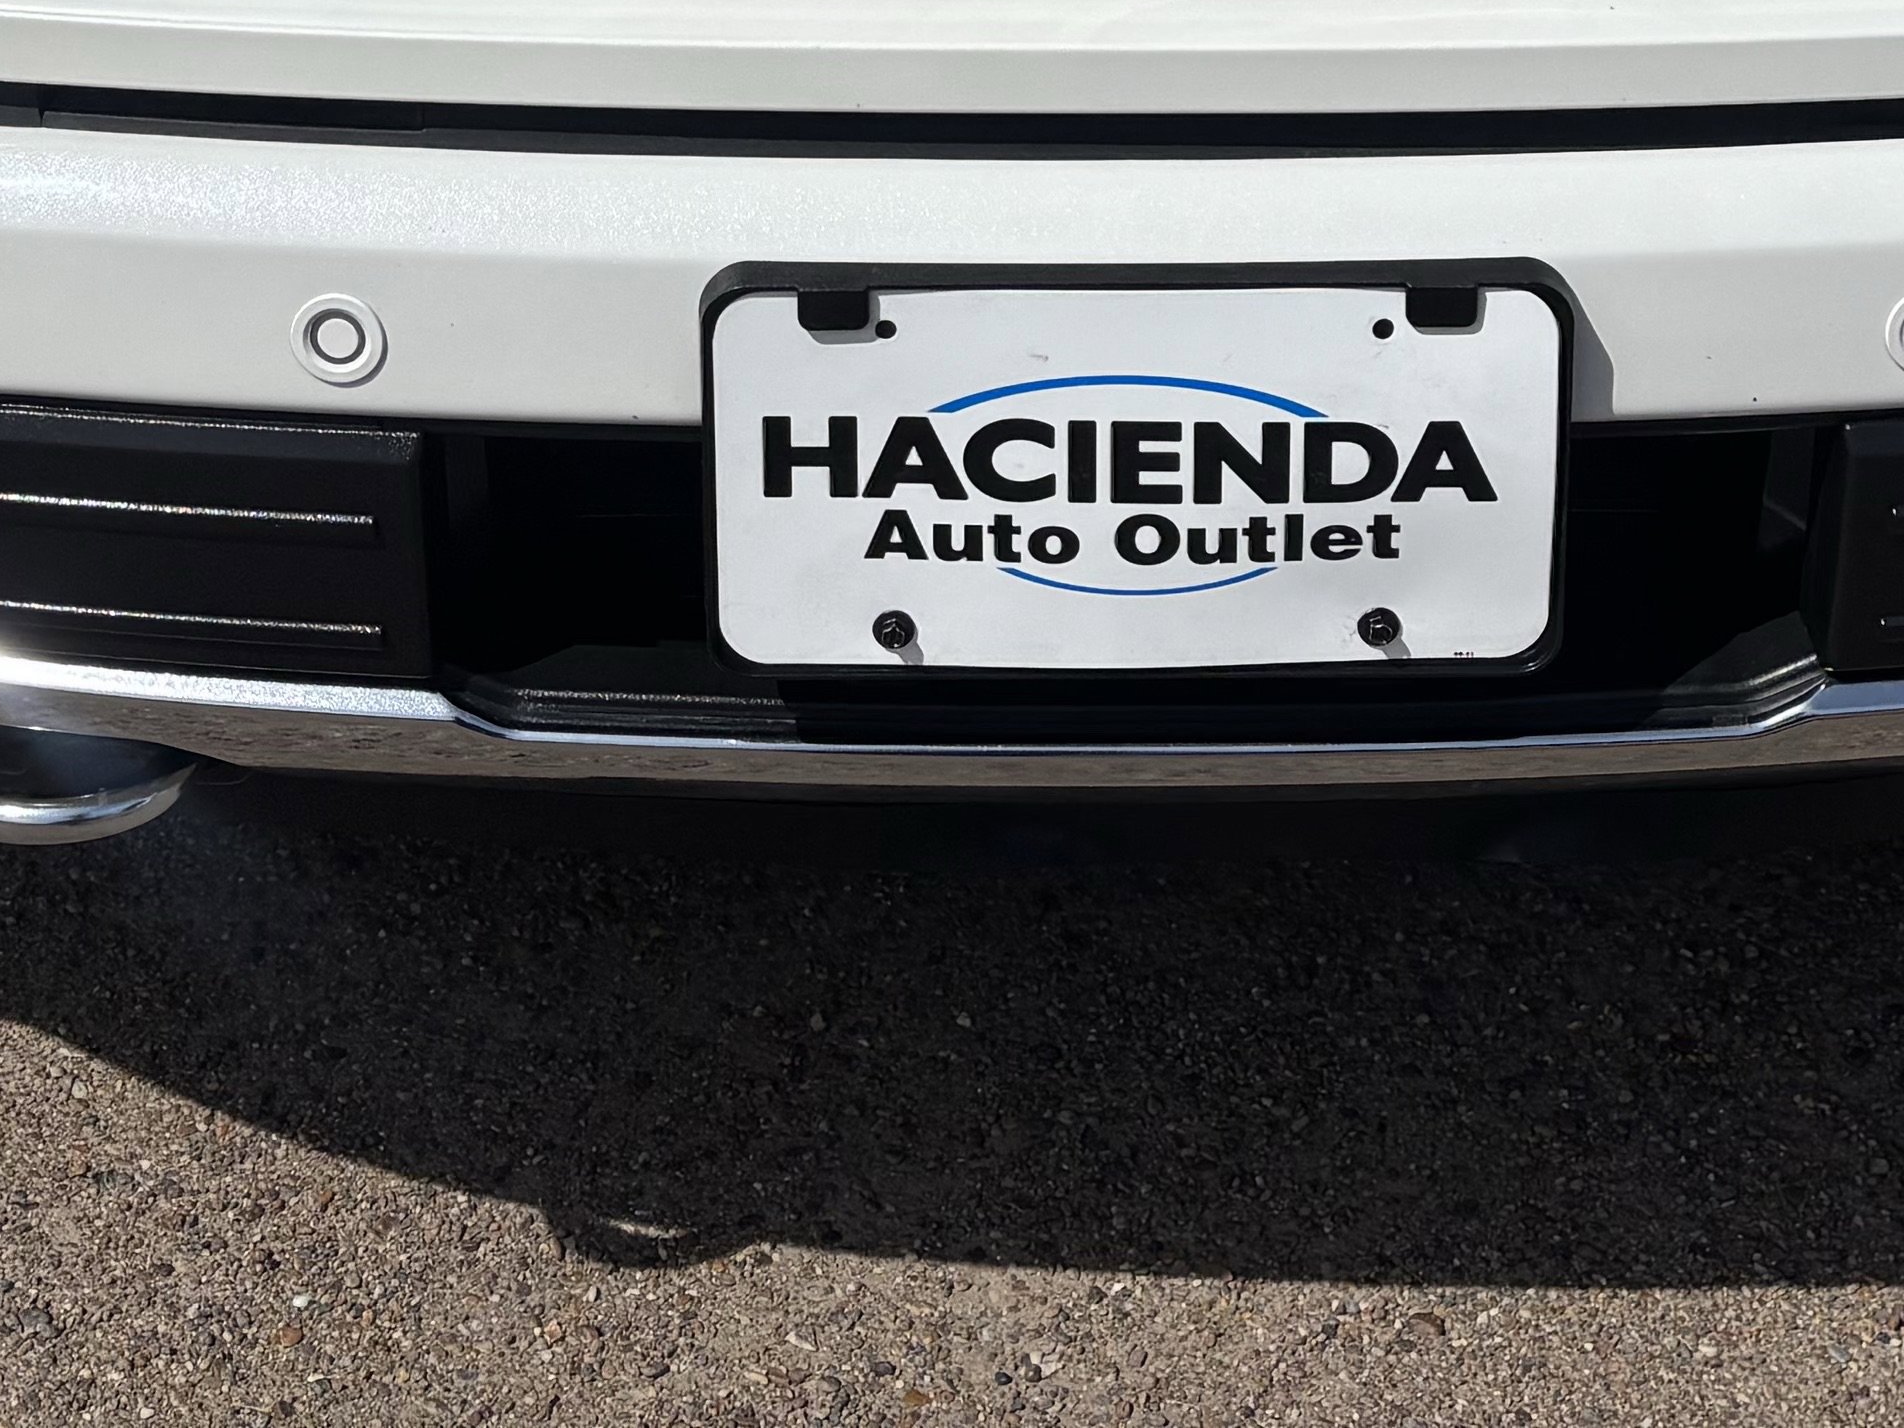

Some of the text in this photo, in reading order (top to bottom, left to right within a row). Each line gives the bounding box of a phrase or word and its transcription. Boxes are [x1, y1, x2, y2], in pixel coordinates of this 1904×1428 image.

[761, 415, 1499, 505] HACIENDA
[863, 509, 1402, 566] Auto Outlet
